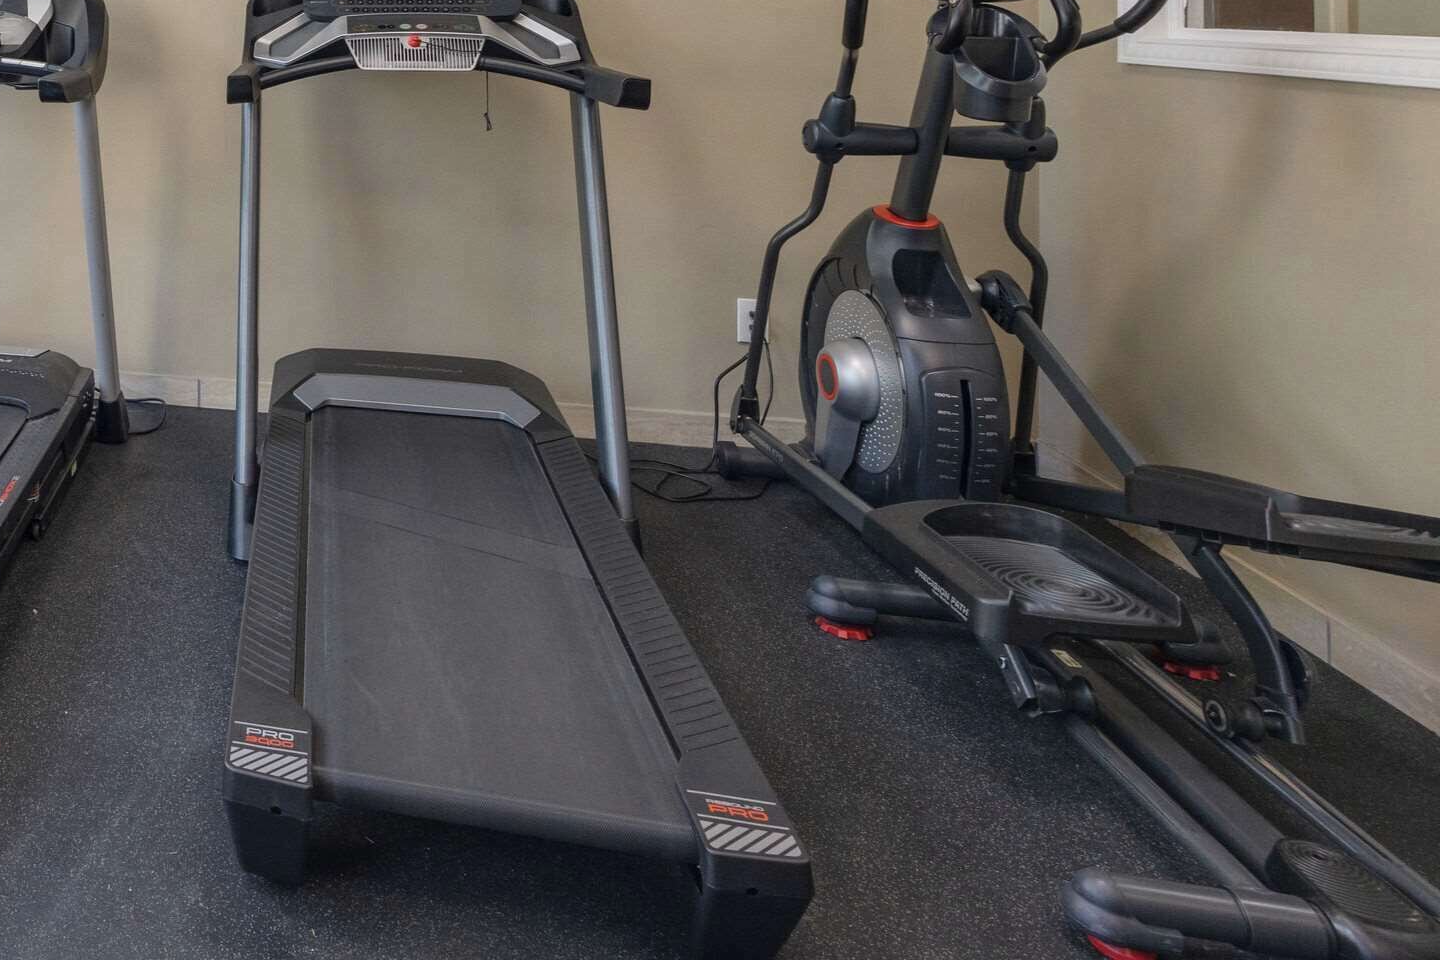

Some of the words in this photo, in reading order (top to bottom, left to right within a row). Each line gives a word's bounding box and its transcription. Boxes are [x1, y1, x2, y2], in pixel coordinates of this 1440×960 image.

[914, 566, 951, 601] PRECISION
[950, 595, 969, 617] PATH
[246, 727, 295, 742] PRO
[708, 803, 769, 822] PRO
